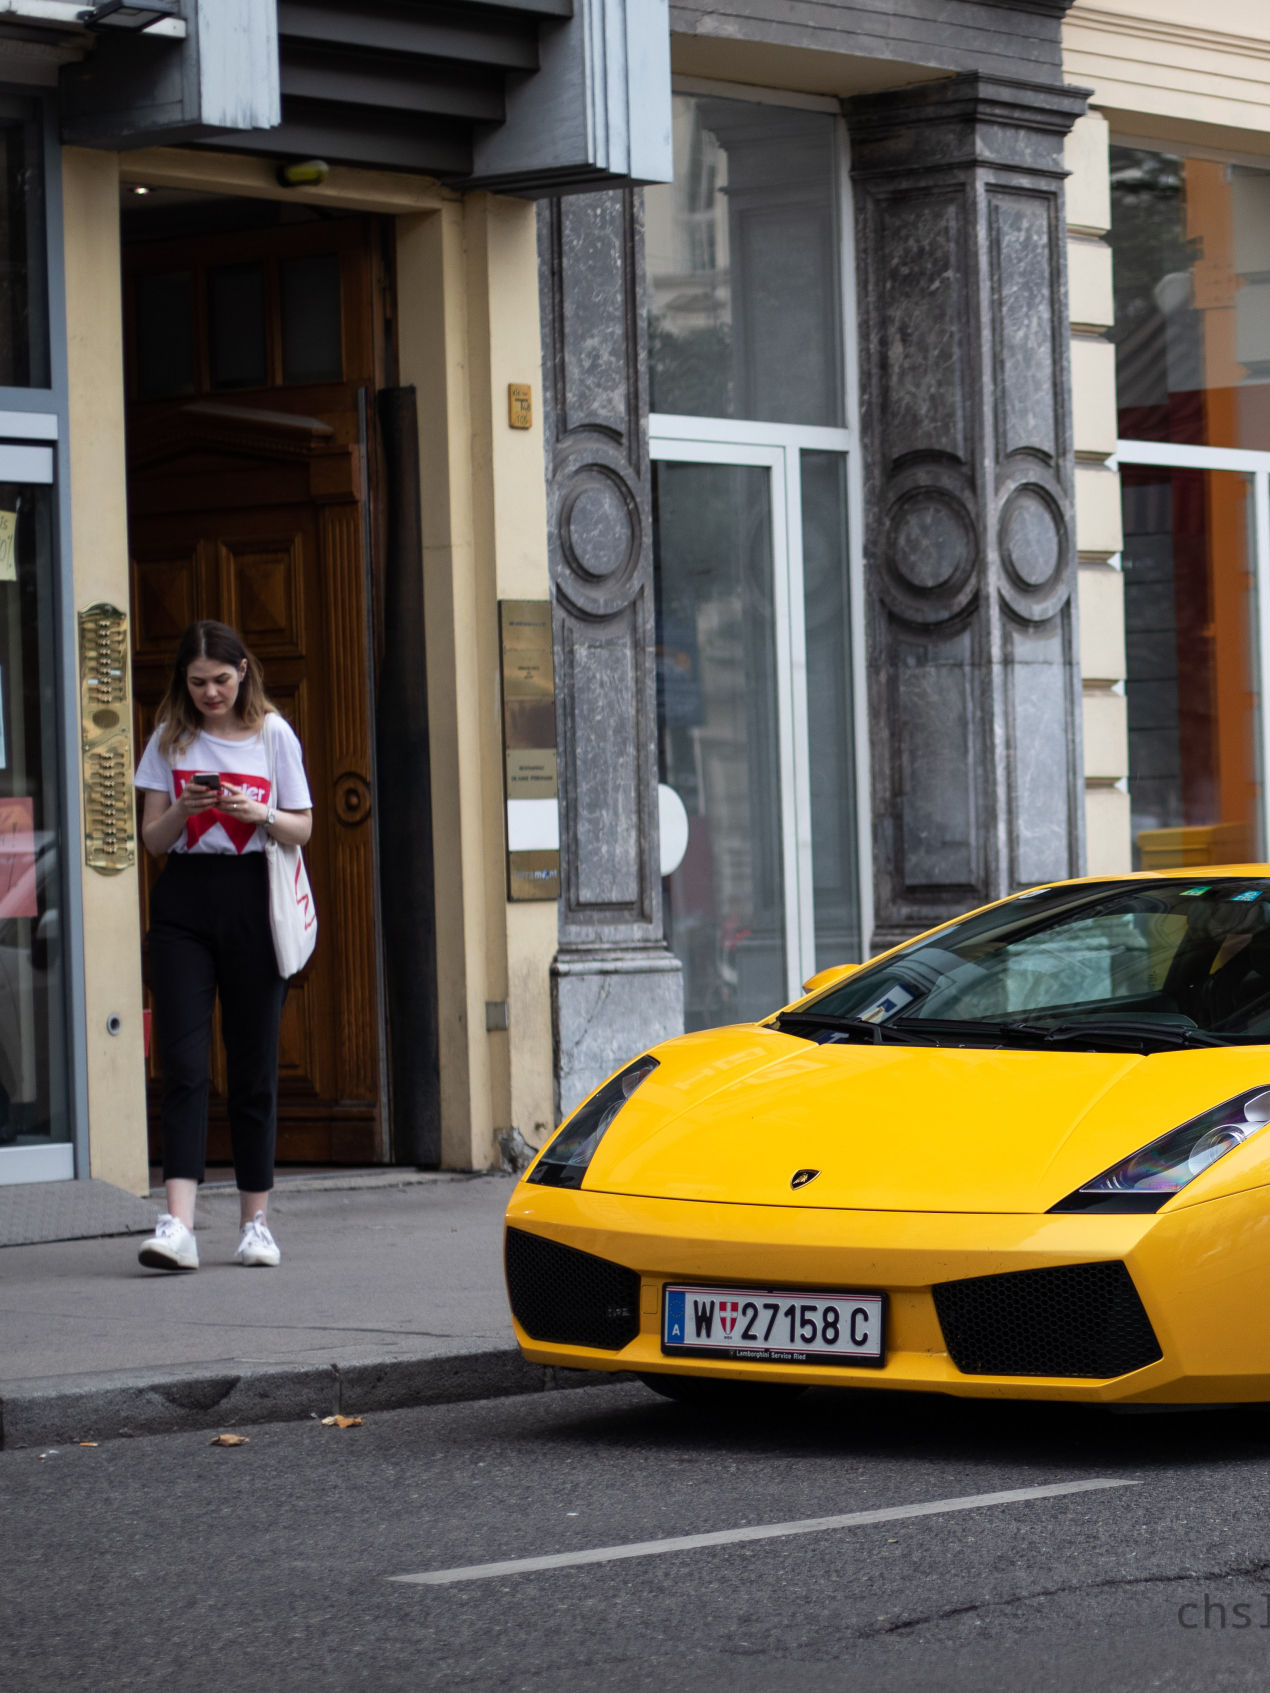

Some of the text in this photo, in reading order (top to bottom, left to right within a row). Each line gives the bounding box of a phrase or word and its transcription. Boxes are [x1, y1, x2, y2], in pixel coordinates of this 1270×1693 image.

[671, 1323, 681, 1337] A
[693, 1299, 870, 1347] W 27158 C
[736, 1350, 770, 1358] Lamborghini
